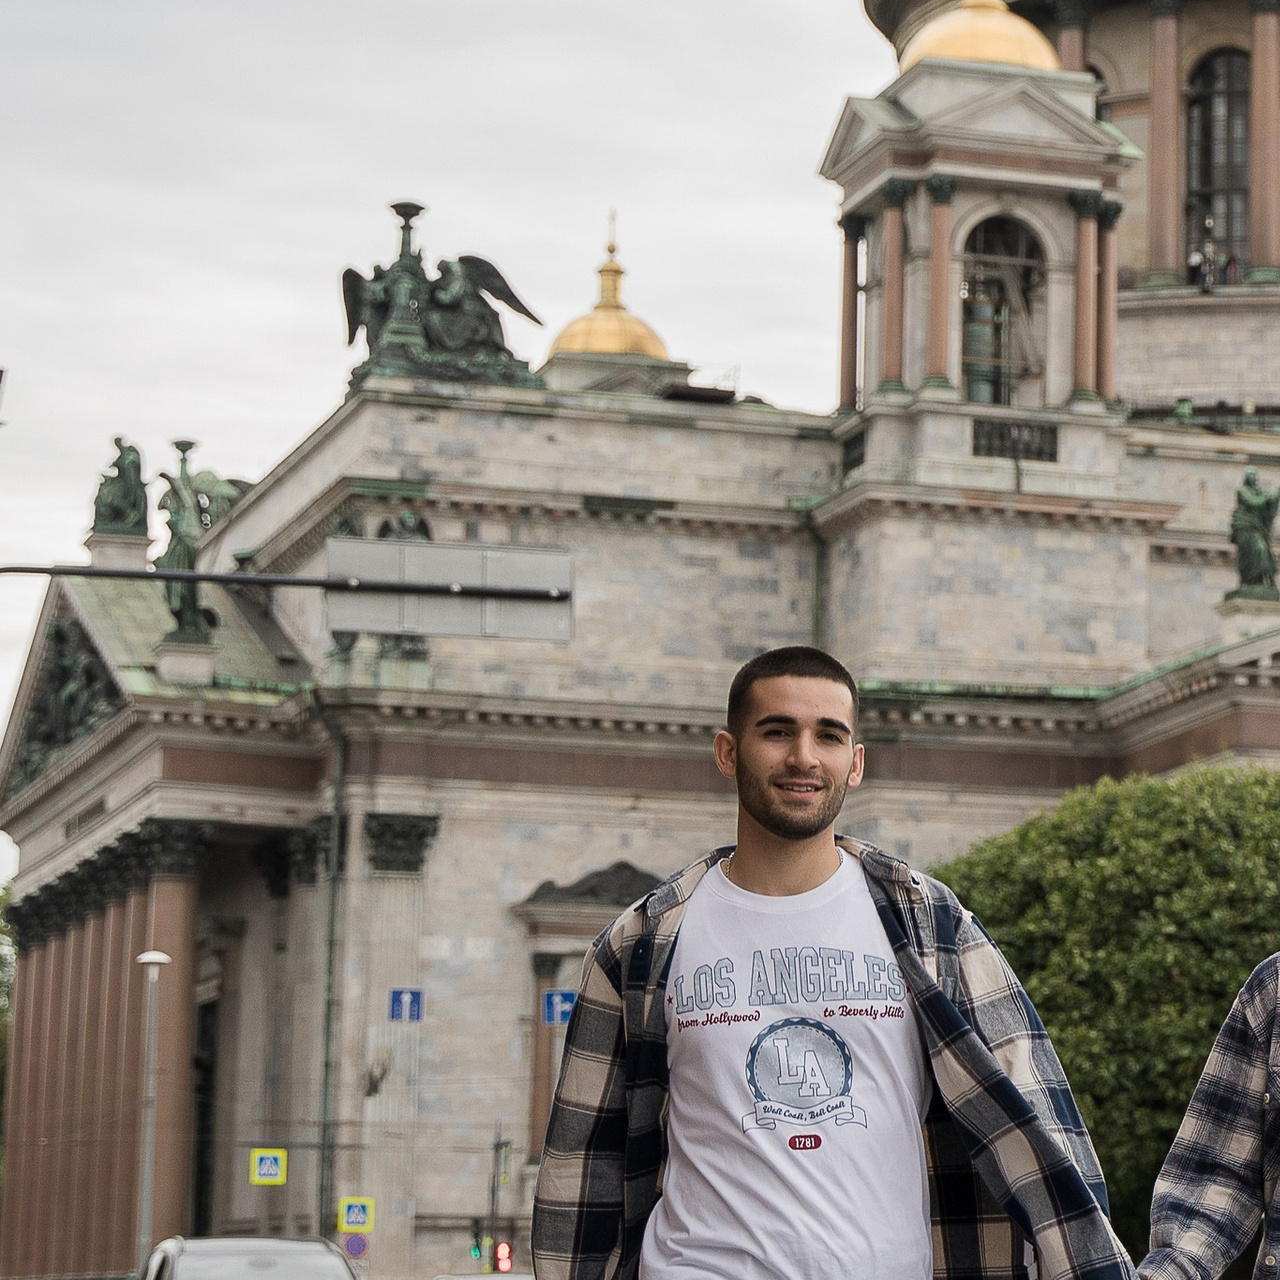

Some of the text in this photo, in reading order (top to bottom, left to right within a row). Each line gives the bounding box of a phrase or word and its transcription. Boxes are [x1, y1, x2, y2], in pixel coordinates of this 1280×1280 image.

[674, 946, 907, 1014] LOS ANGELES
[677, 1004, 905, 1033] from Hollywood to Beverly Hills
[773, 1038, 832, 1098] LA
[762, 1104, 782, 1115] West
[794, 1137, 816, 1149] 1781
